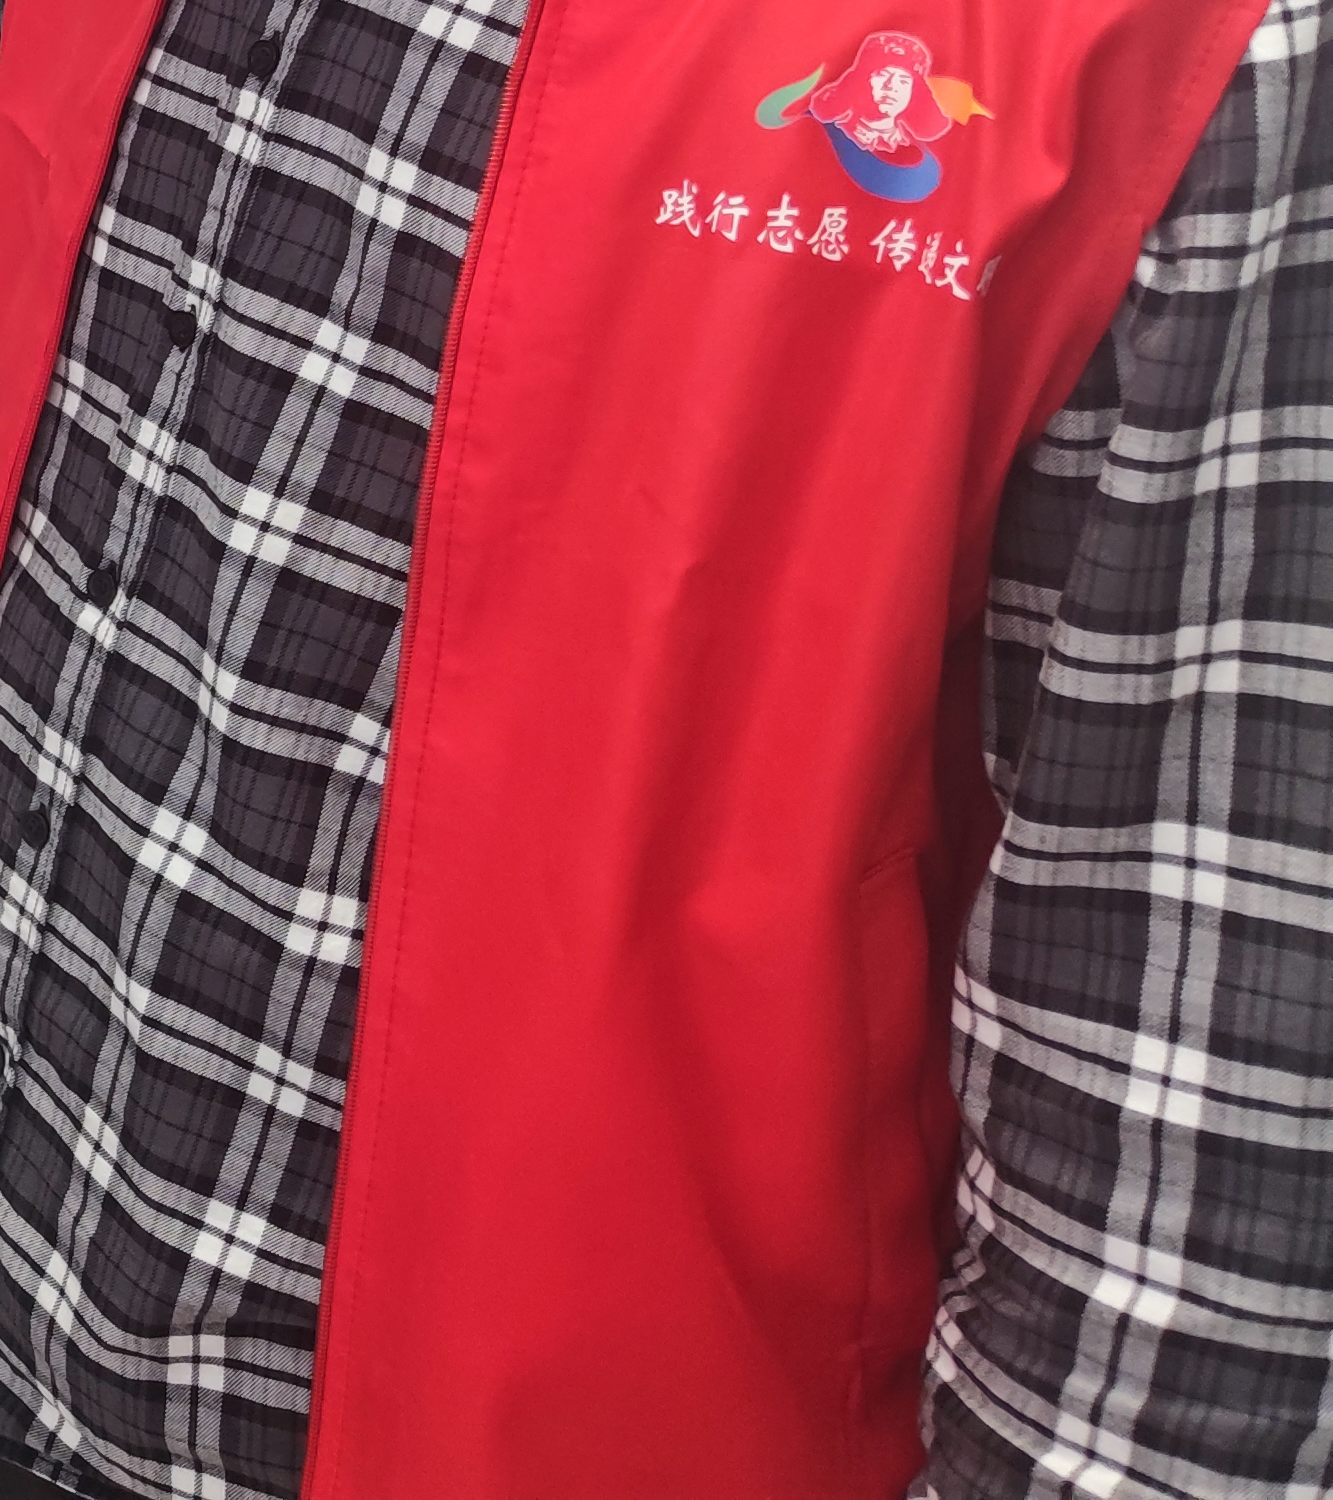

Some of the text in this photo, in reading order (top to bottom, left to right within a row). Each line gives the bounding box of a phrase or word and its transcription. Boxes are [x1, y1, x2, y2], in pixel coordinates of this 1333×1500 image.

[654, 178, 1003, 301] 践行志愿 传文
